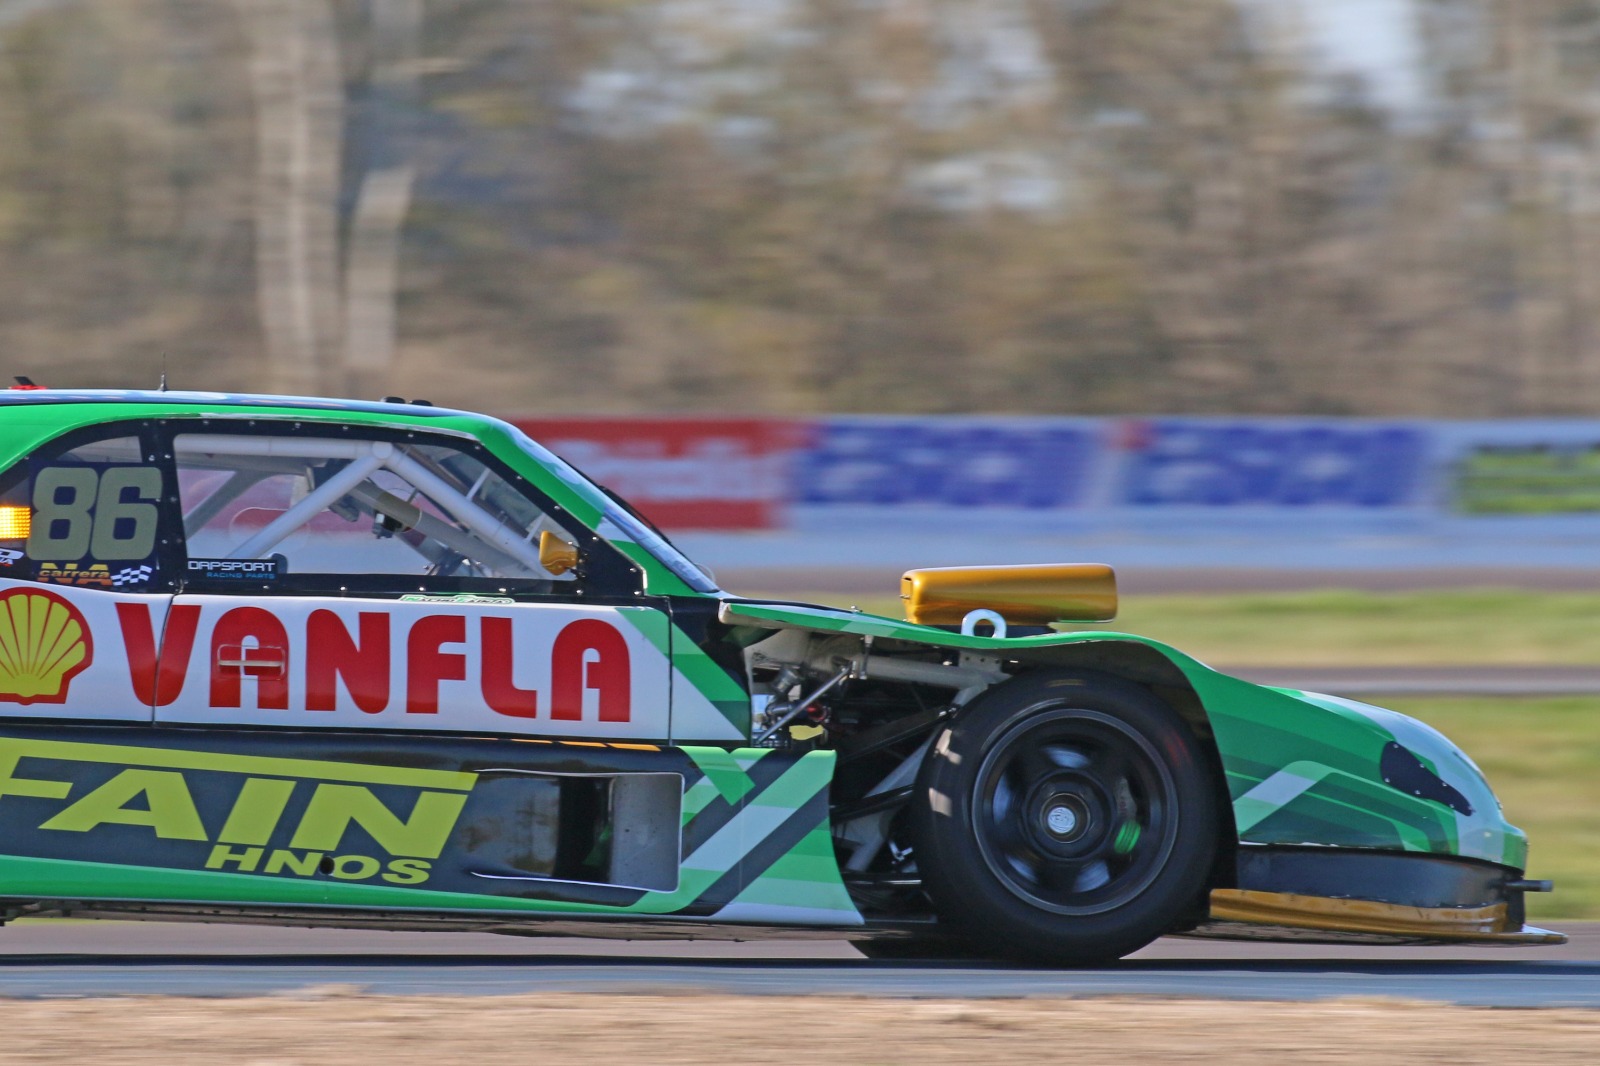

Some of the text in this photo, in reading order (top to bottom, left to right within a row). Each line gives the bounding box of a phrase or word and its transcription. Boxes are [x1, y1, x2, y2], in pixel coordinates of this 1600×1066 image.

[26, 467, 163, 560] 86
[38, 569, 111, 579] carrera
[206, 571, 276, 580] RACING PARTS
[115, 602, 631, 723] VANFLA
[204, 845, 432, 885] HNOS
